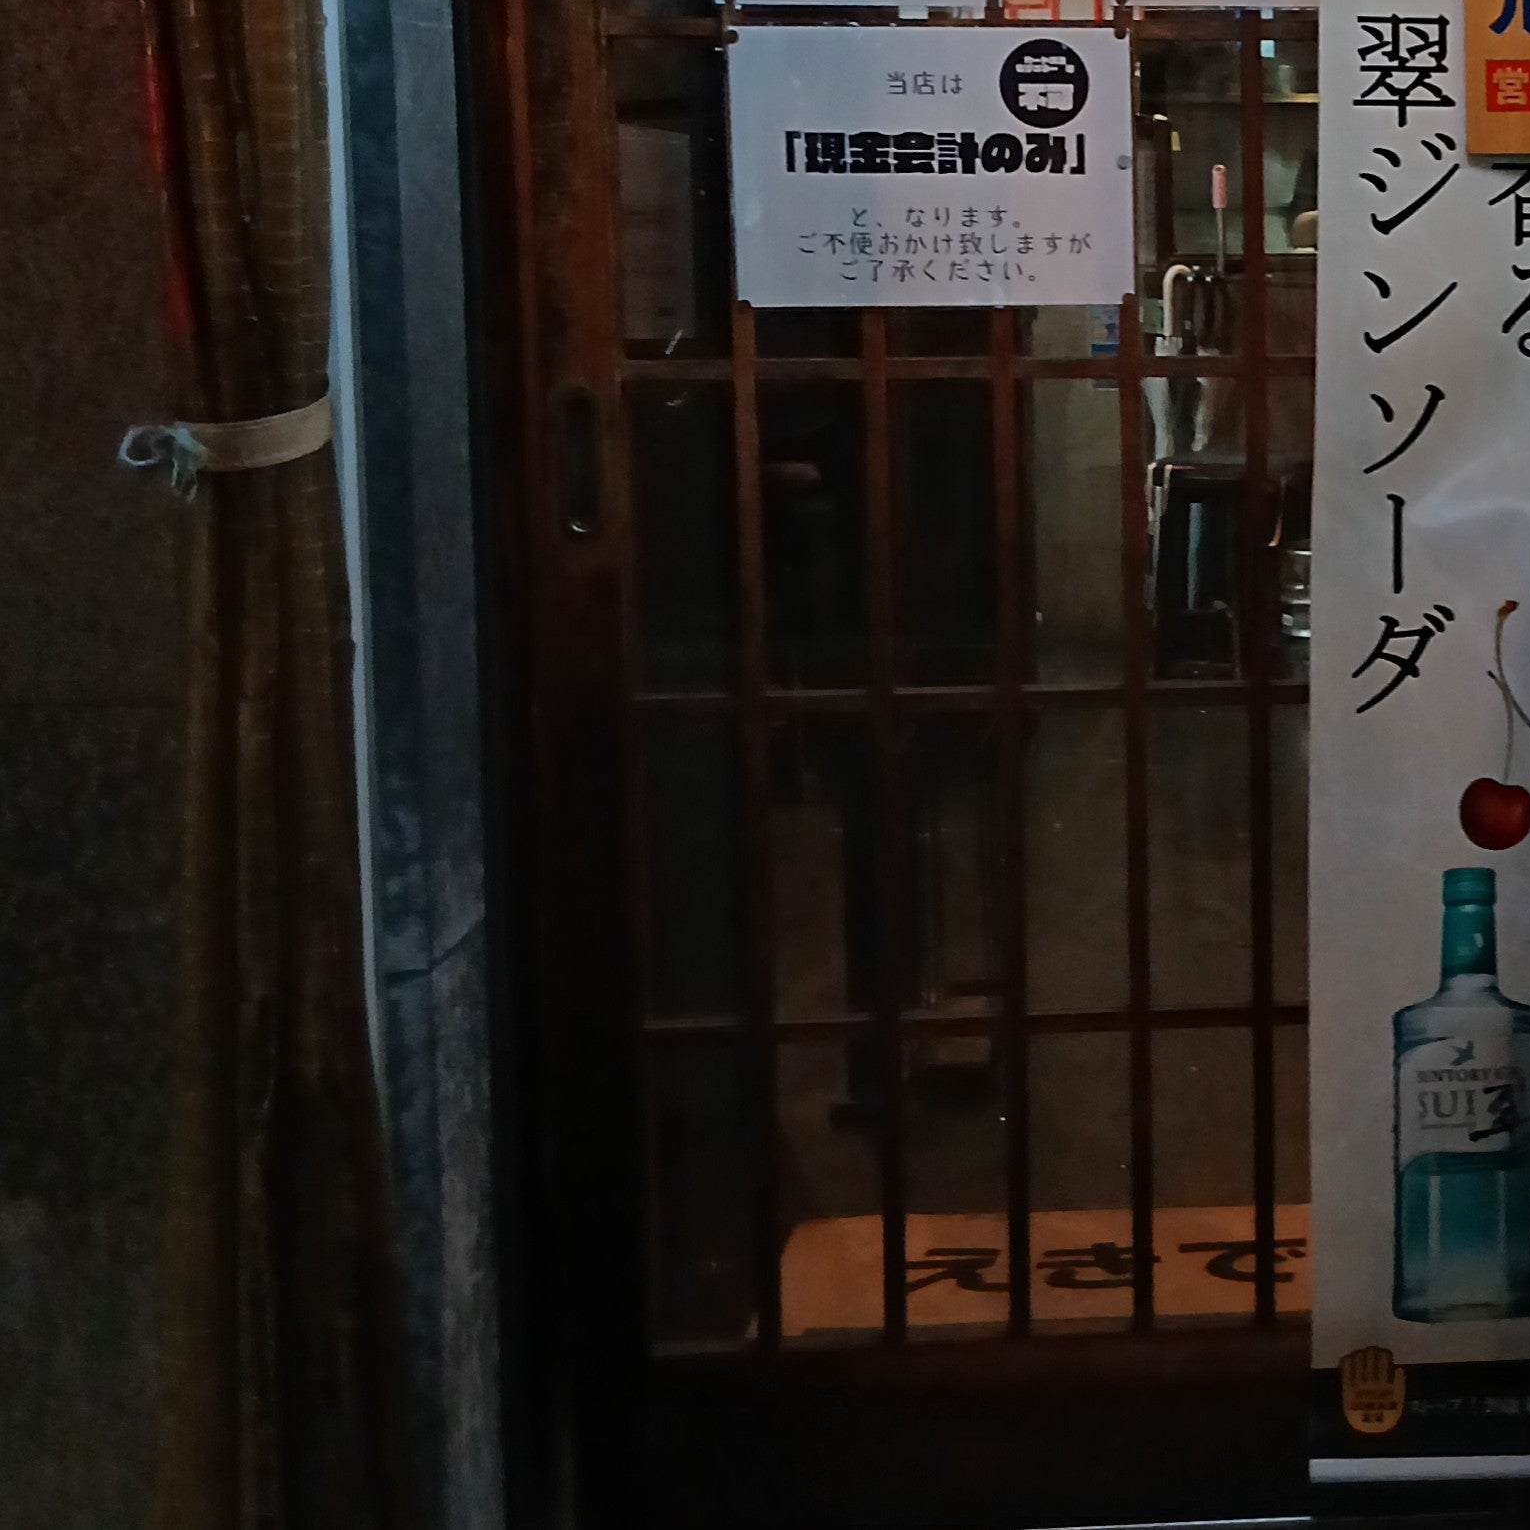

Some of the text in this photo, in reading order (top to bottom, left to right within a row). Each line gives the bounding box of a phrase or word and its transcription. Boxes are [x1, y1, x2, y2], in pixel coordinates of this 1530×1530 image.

[887, 70, 963, 95] 当店は
[785, 130, 1087, 174] 「現金会計のみ」
[1353, 13, 1456, 714] 翠ジンソーダ
